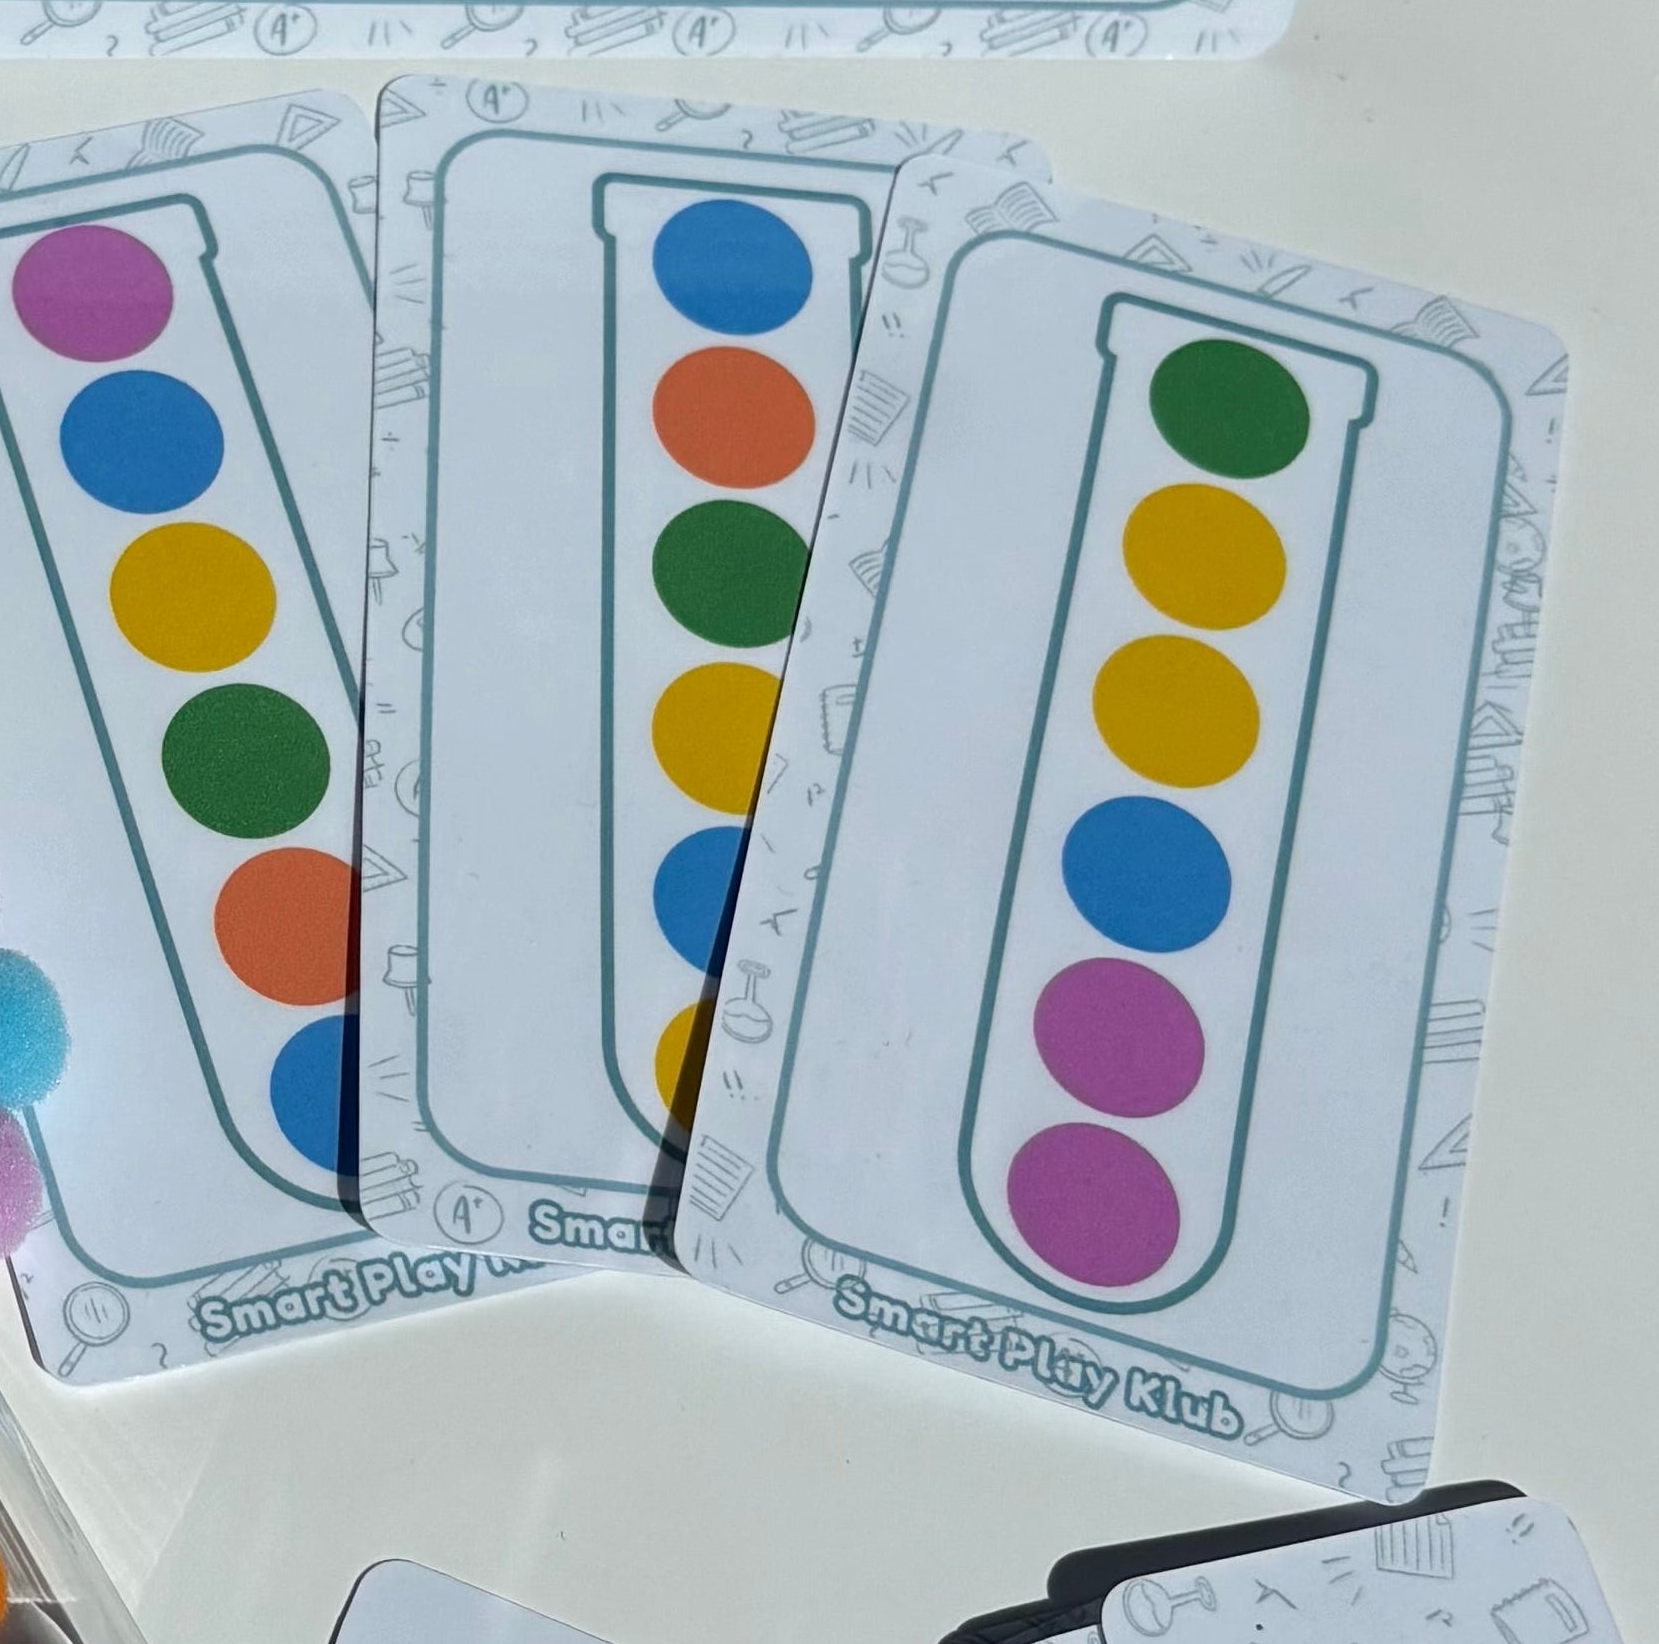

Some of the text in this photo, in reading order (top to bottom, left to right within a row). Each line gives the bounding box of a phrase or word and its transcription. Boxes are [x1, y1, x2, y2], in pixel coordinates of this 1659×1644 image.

[529, 1198, 675, 1257] Smar
[195, 1270, 358, 1343] Smart
[355, 1250, 476, 1308] Play
[834, 1274, 1243, 1440] Smart Play Klub
